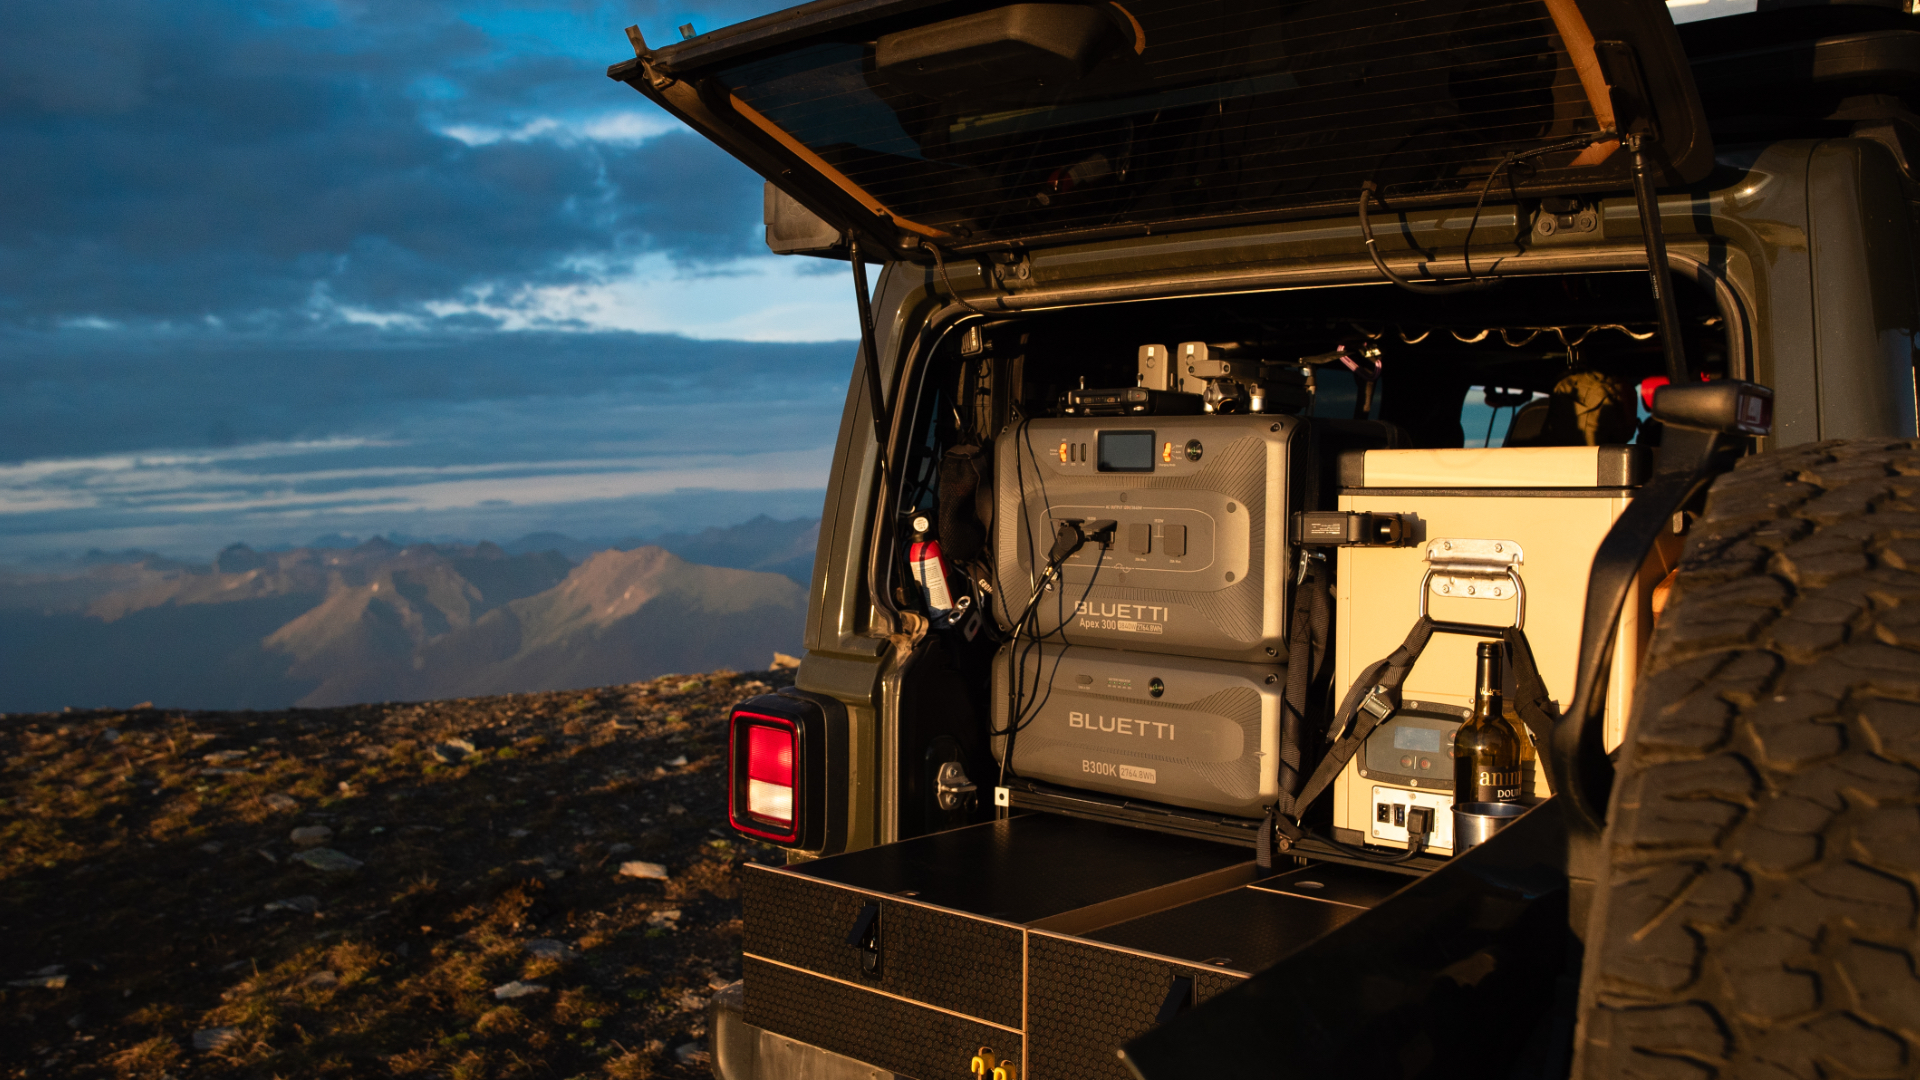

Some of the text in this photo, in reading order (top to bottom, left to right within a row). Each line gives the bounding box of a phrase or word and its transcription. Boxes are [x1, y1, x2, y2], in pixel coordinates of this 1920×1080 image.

[1074, 600, 1168, 622] BLUETTI
[1079, 617, 1100, 630] Apex
[1101, 619, 1117, 631] 300
[1069, 711, 1175, 741] BLUETTI
[1082, 759, 1155, 781] B300K 2764.8Wh
[1479, 766, 1522, 787] anim
